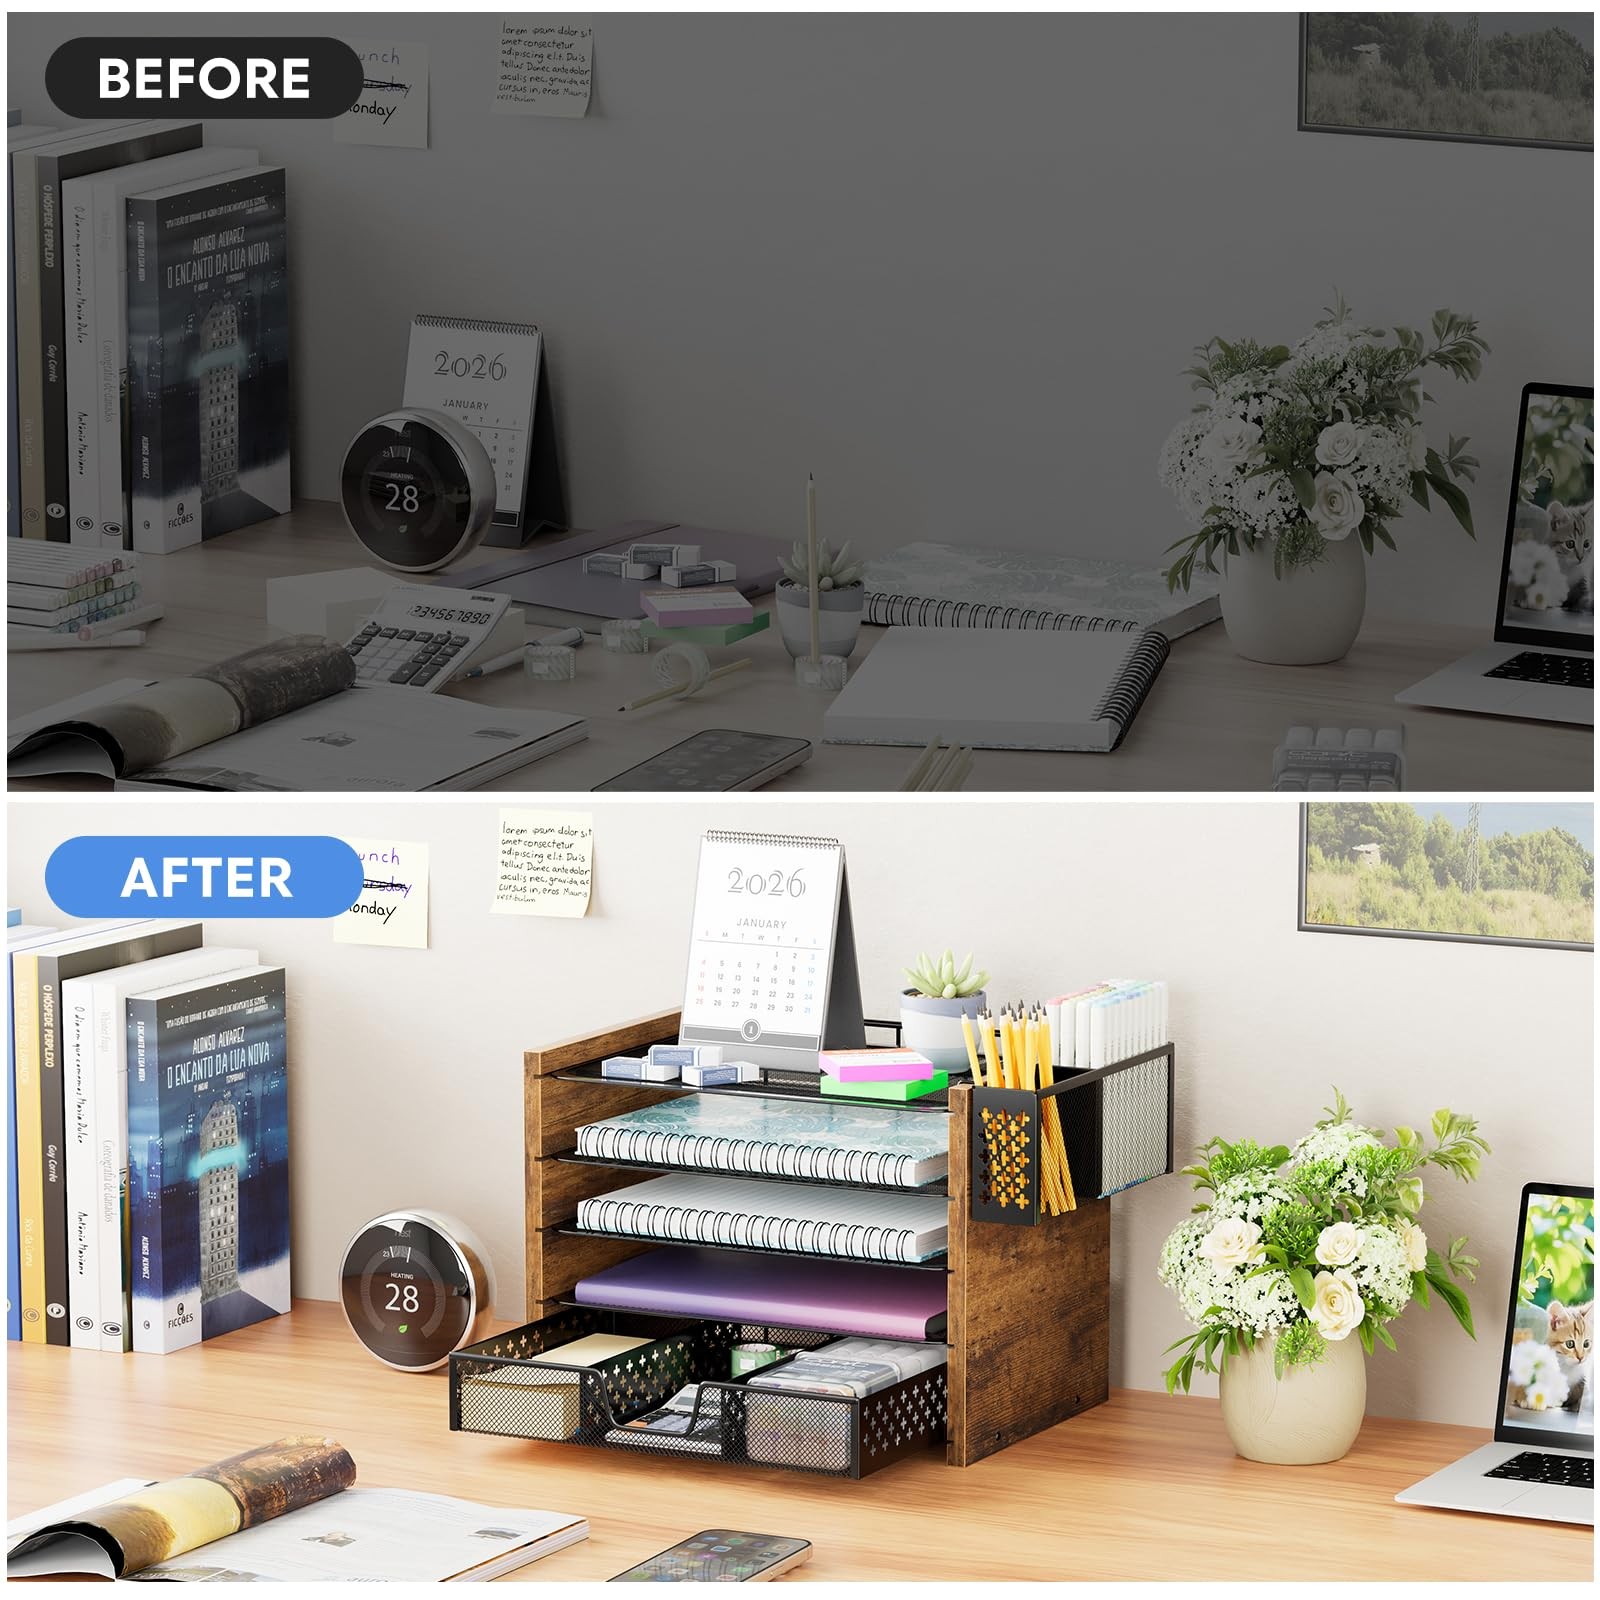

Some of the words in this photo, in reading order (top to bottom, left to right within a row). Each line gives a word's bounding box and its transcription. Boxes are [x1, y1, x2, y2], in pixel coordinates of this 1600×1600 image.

[358, 47, 400, 65] unch
[349, 101, 397, 125] onday
[192, 234, 215, 254] ALONSO
[218, 226, 245, 249] ALVAREZ
[167, 266, 173, 289] O
[176, 256, 213, 287] ENCANTO
[216, 253, 228, 276] DA
[230, 249, 246, 271] LUA
[249, 241, 270, 267] NOVA
[434, 351, 507, 381] 2026
[442, 399, 489, 410] JANUARY
[390, 472, 414, 480] HEATING
[385, 483, 419, 513] 28
[558, 825, 579, 837] dolor
[581, 829, 592, 838] sit
[501, 847, 544, 864] adipiscing
[567, 853, 586, 863] Duis
[523, 840, 575, 850] consectetur
[358, 847, 400, 865] unch
[501, 860, 524, 870] tellus
[527, 862, 550, 872] Donec
[499, 884, 527, 894] cursus
[542, 888, 560, 896] eros
[728, 867, 806, 897] 2026
[349, 901, 397, 925] onday
[736, 918, 787, 929] JANUARY
[44, 1029, 55, 1069] PERPLEXO
[192, 1034, 215, 1054] ALONSO
[218, 1026, 245, 1049] ALVAREZ
[167, 1066, 173, 1089] O
[176, 1056, 213, 1087] ENCANTO
[216, 1053, 228, 1076] DA
[230, 1049, 246, 1071] LUA
[249, 1041, 270, 1067] NOVA
[390, 1272, 414, 1280] HEATING
[385, 1283, 419, 1313] 28
